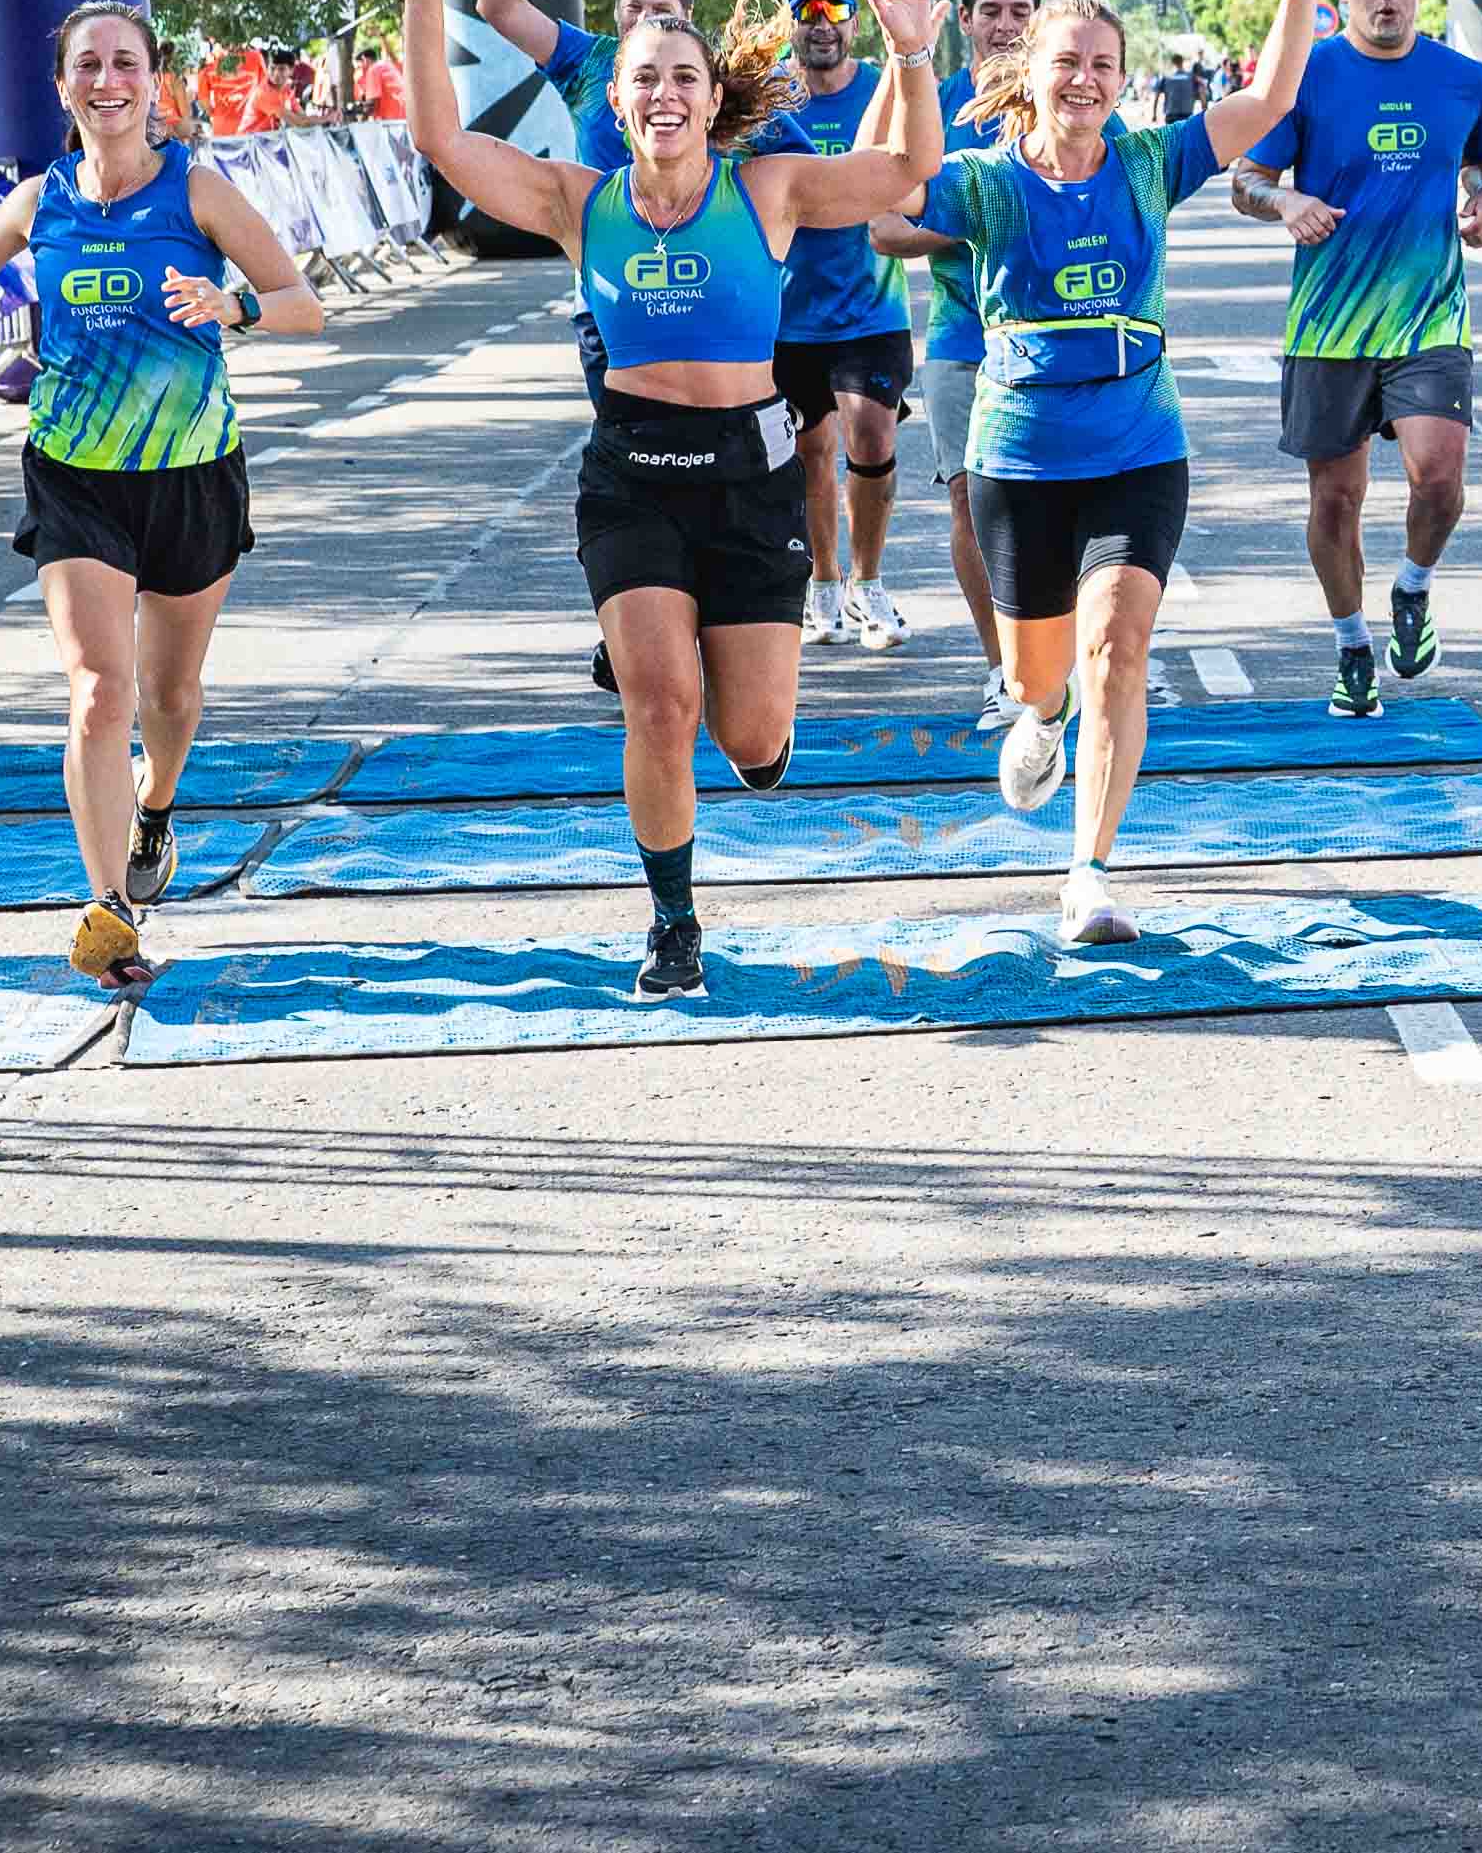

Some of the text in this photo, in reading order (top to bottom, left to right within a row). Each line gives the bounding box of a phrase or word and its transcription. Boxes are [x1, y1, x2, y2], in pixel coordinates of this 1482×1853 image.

[81, 241, 126, 254] HARLEM
[631, 288, 705, 302] FUNCIONAL
[70, 304, 136, 317] FUNCIONAL
[646, 301, 693, 317] Outdoor
[1062, 297, 1122, 313] FUNCIONAL
[628, 450, 716, 469] noaflojes
